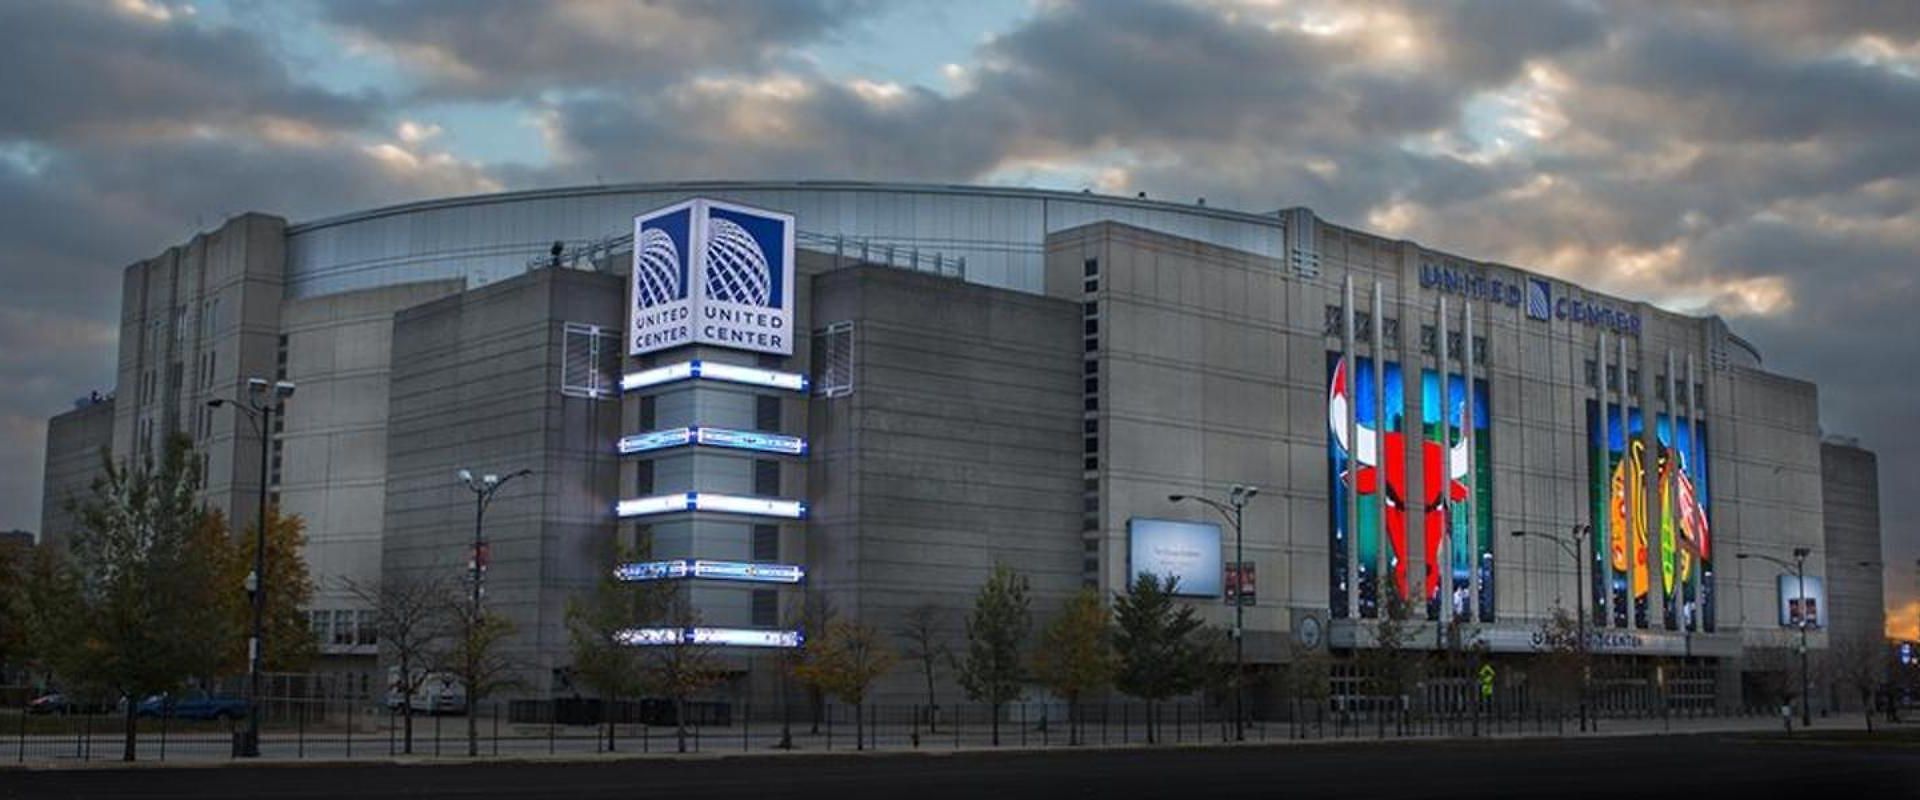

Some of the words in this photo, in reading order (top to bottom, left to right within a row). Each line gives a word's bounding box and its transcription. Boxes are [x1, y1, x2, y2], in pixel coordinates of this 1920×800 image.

[1420, 263, 1522, 308] UNITED
[1554, 298, 1642, 336] CENTER
[636, 306, 689, 330] UNITED
[704, 306, 784, 329] UNITED
[635, 326, 688, 349] CENTER
[704, 325, 782, 349] CENTER
